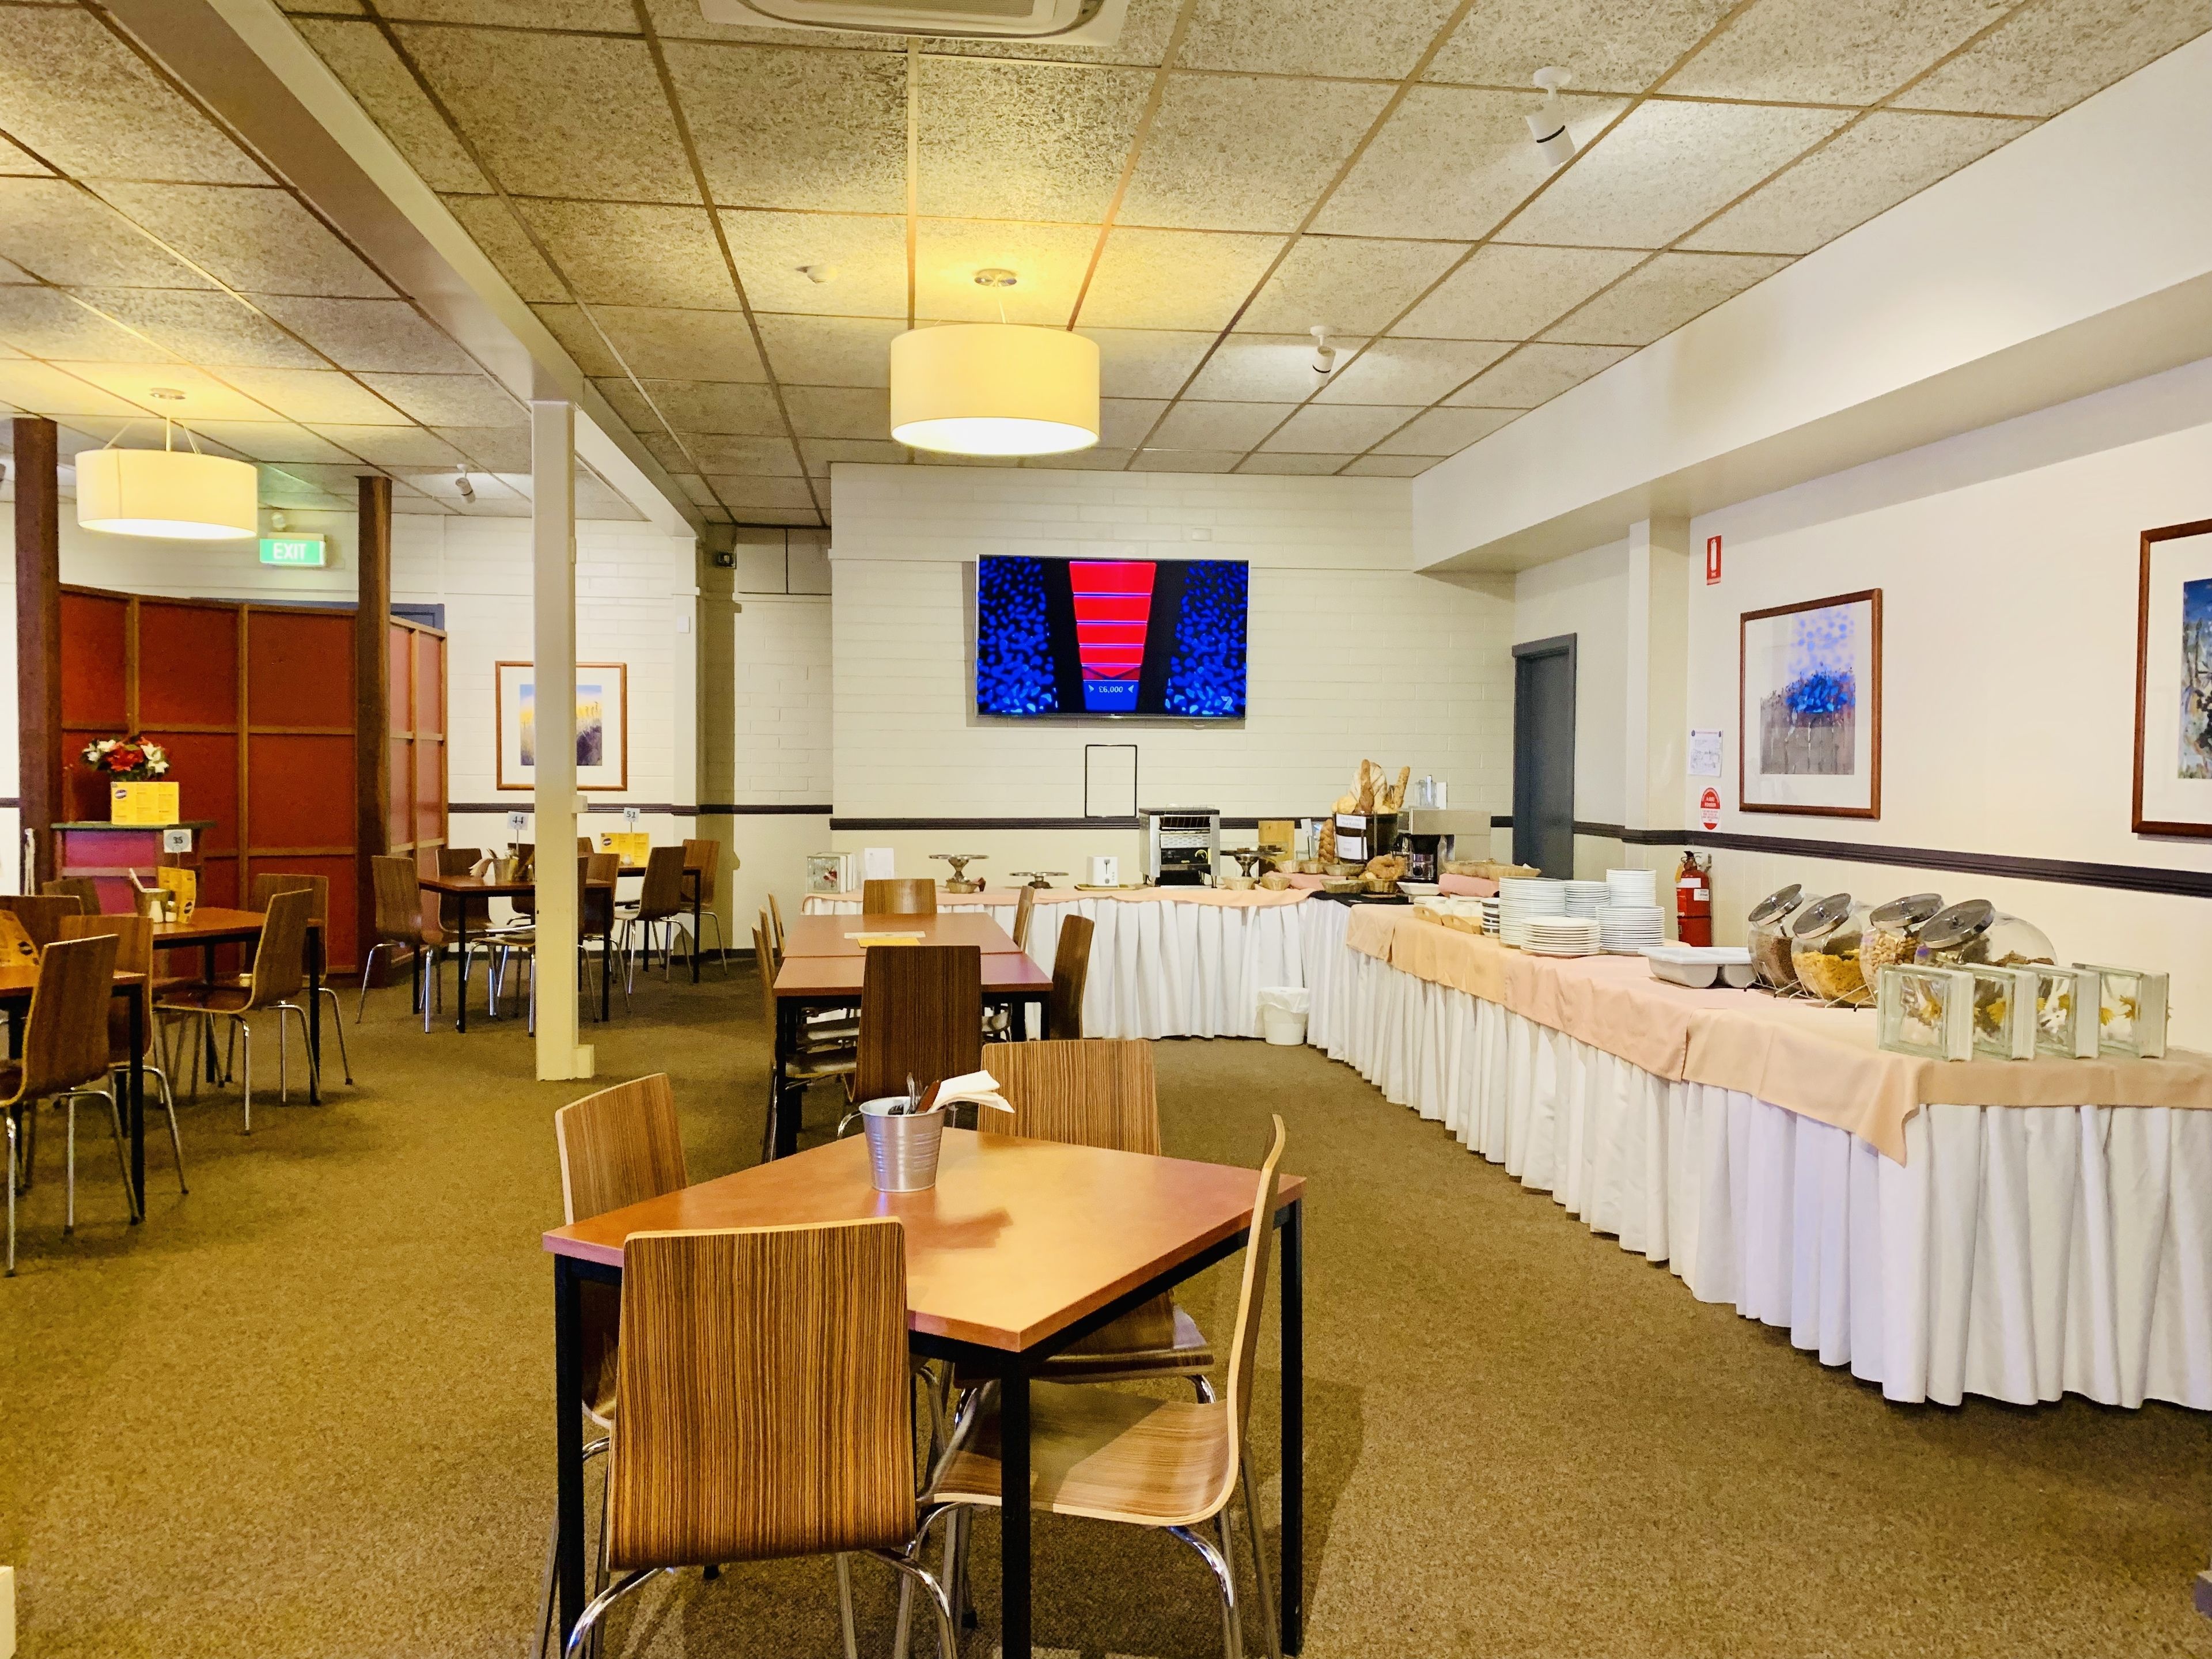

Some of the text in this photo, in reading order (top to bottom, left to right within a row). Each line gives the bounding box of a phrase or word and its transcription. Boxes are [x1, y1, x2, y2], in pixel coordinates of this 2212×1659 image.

[274, 543, 306, 560] EXIT
[1099, 685, 1124, 694] £6,000
[513, 816, 524, 824] 44
[173, 836, 183, 844] 35
